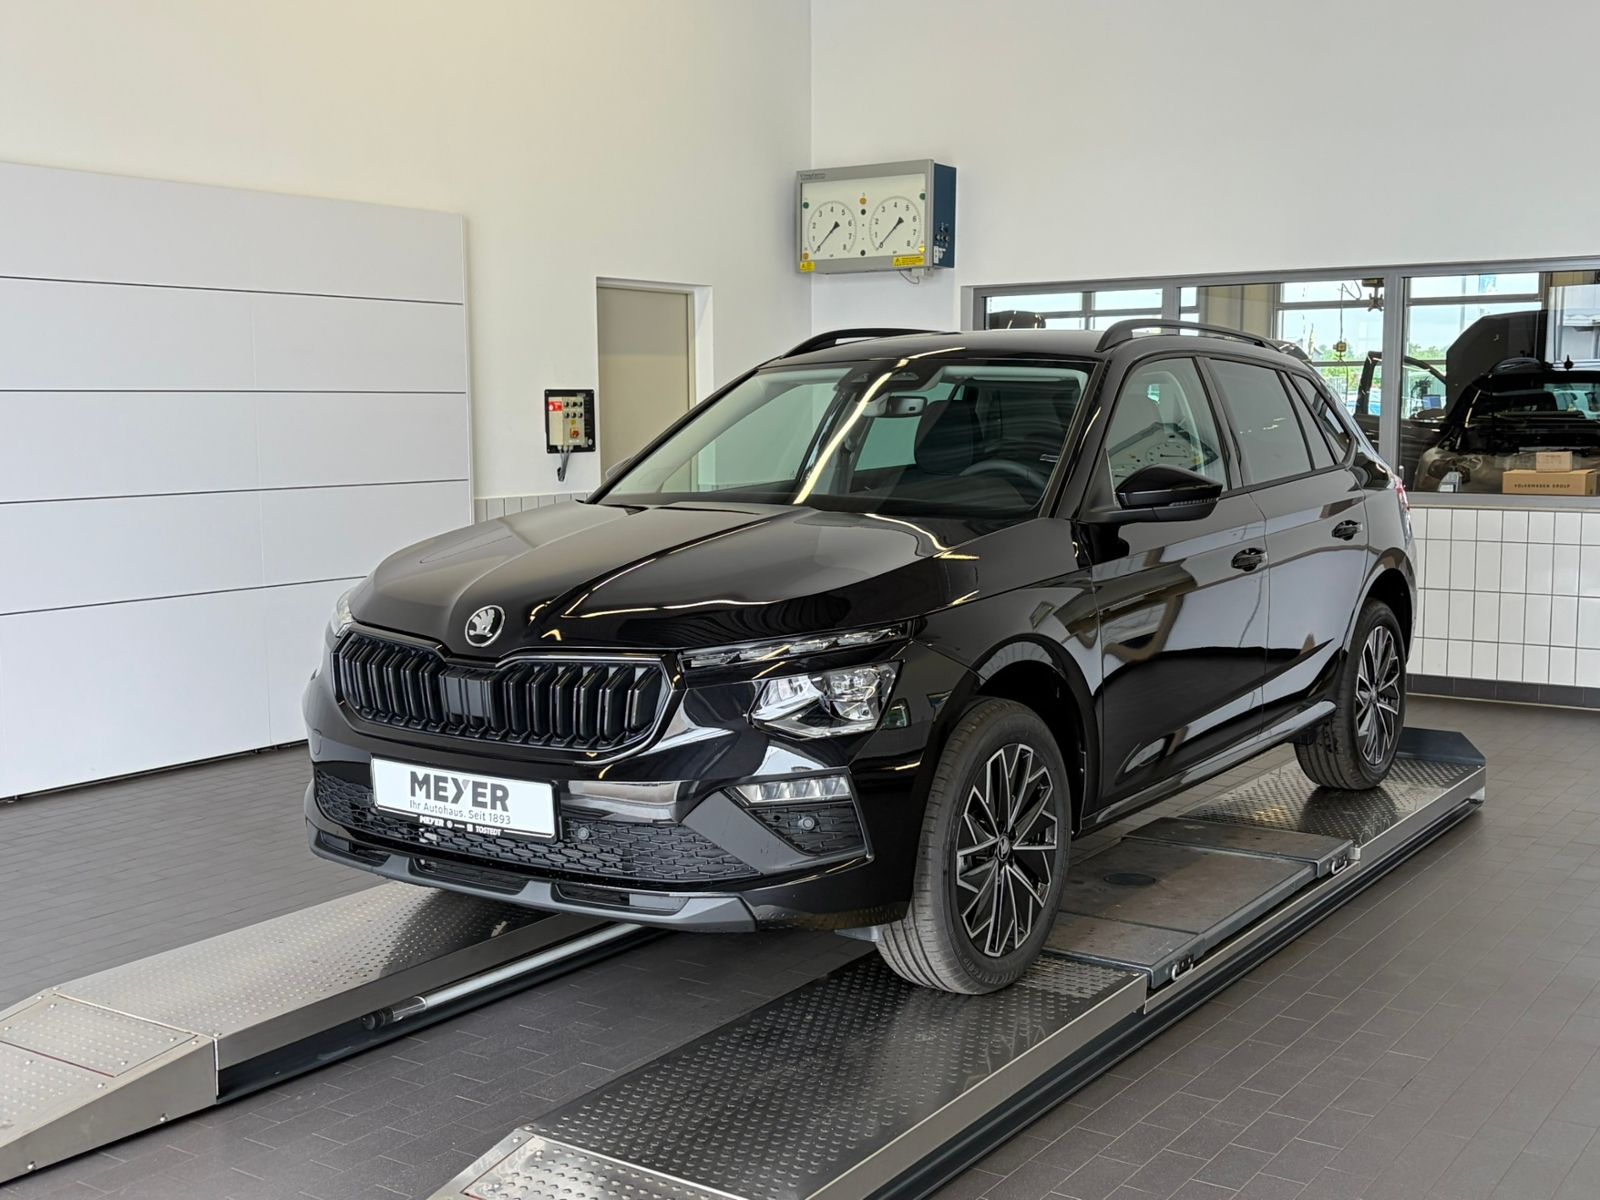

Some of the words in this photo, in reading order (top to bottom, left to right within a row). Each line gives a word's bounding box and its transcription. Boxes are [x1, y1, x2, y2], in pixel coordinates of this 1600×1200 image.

[410, 770, 509, 812] MEYER
[409, 799, 421, 808] Ihr
[423, 802, 467, 818] Autohaus.
[468, 810, 487, 821] Seit
[489, 813, 511, 825] 1893
[419, 815, 445, 828] MEYER
[475, 825, 502, 836] TOSTEDT
